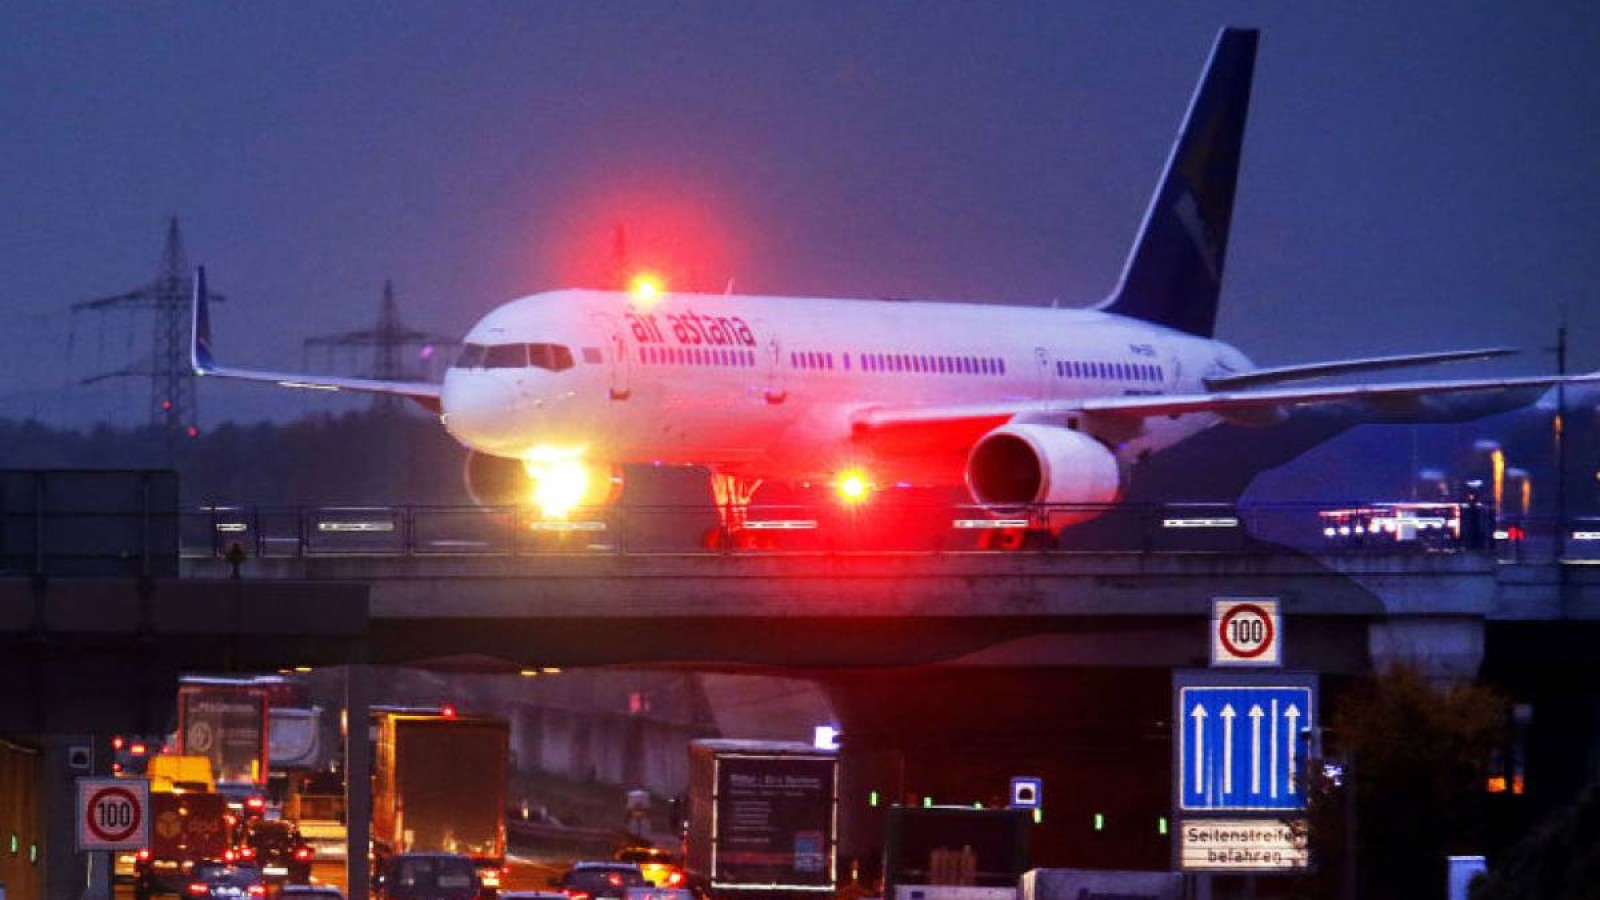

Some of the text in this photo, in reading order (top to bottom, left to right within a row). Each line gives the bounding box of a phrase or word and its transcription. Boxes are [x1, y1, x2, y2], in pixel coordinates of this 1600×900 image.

[624, 310, 757, 347] air astana
[1230, 619, 1262, 644] 100
[96, 802, 130, 827] 100
